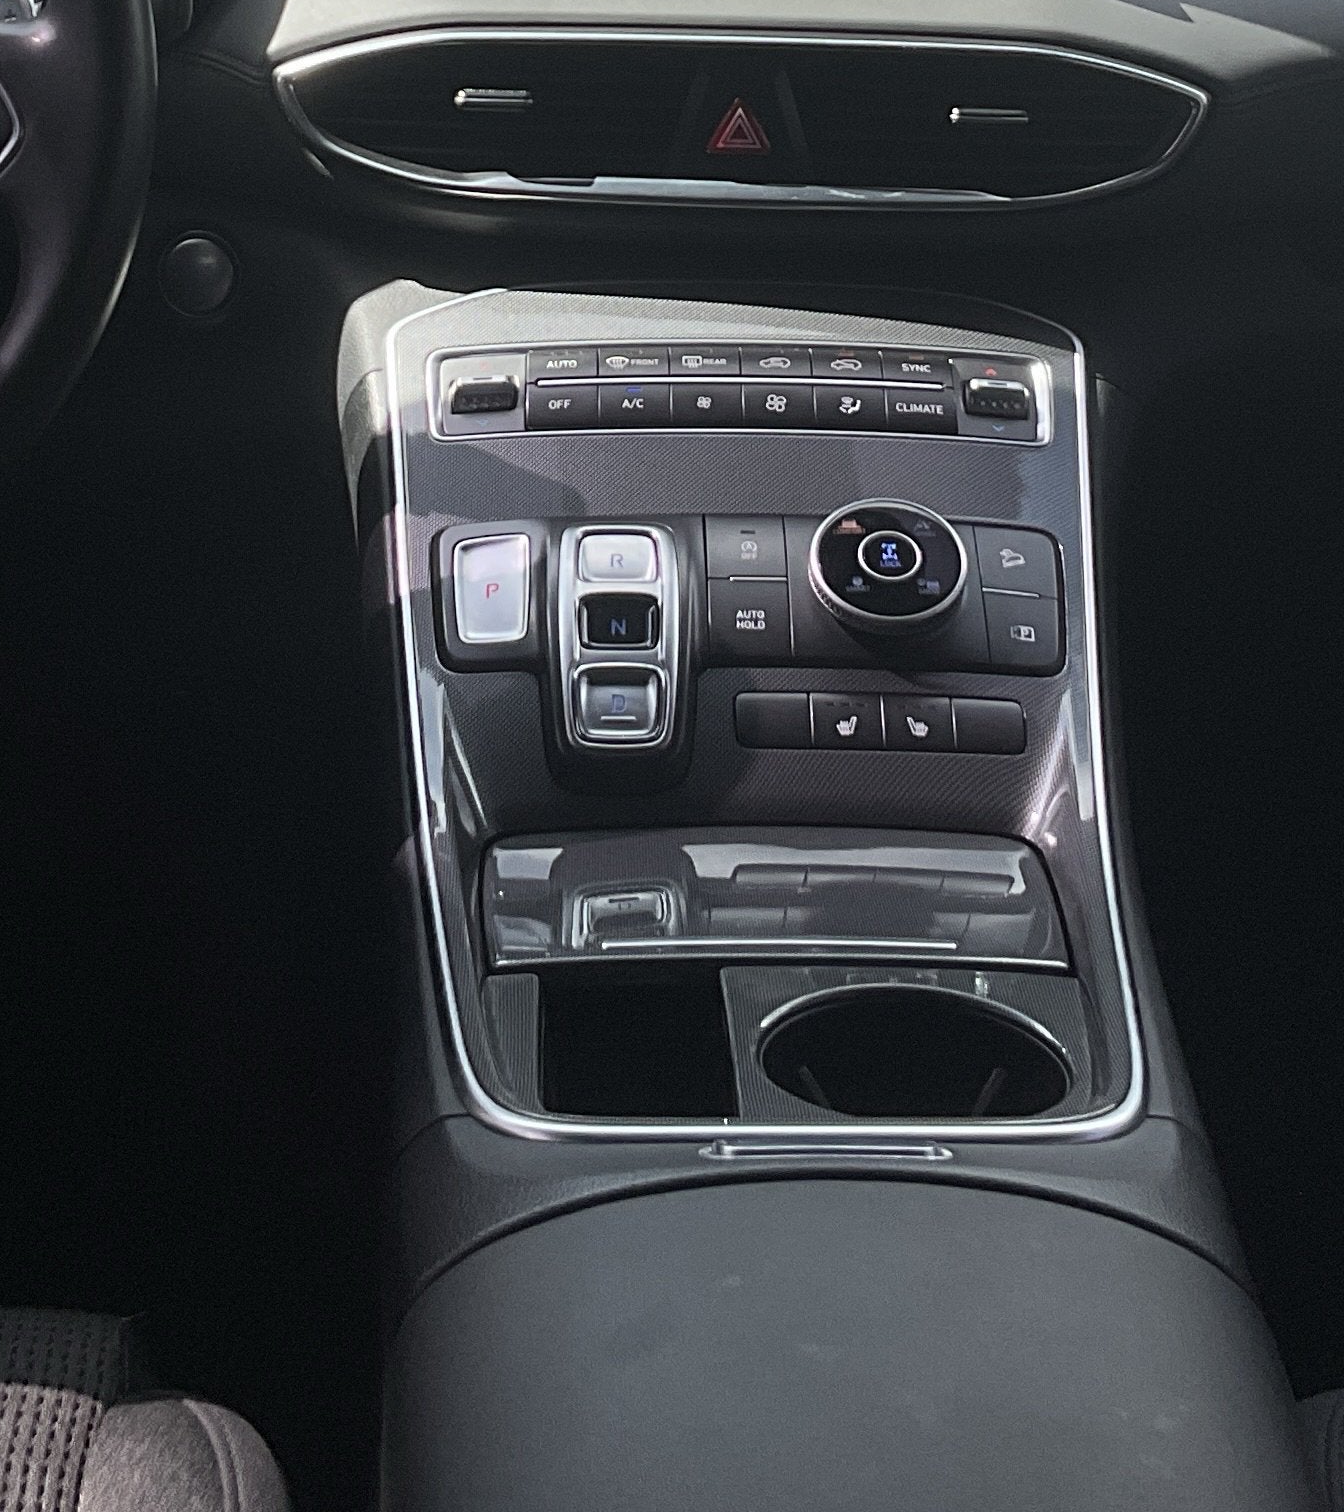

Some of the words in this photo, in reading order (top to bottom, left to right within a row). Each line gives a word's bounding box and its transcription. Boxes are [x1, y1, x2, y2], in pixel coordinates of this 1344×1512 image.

[546, 359, 578, 370] AUTO
[630, 358, 659, 366] FRONT
[703, 358, 727, 366] REAR
[901, 363, 932, 374] SYNC
[548, 399, 572, 410] OFF
[621, 398, 645, 409] A/C
[895, 402, 945, 416] CLIMATE
[610, 554, 624, 568] R
[486, 582, 500, 600] P
[736, 610, 765, 620] AUTO
[610, 617, 627, 636] N
[736, 620, 766, 630] HOLD
[611, 694, 626, 713] D
